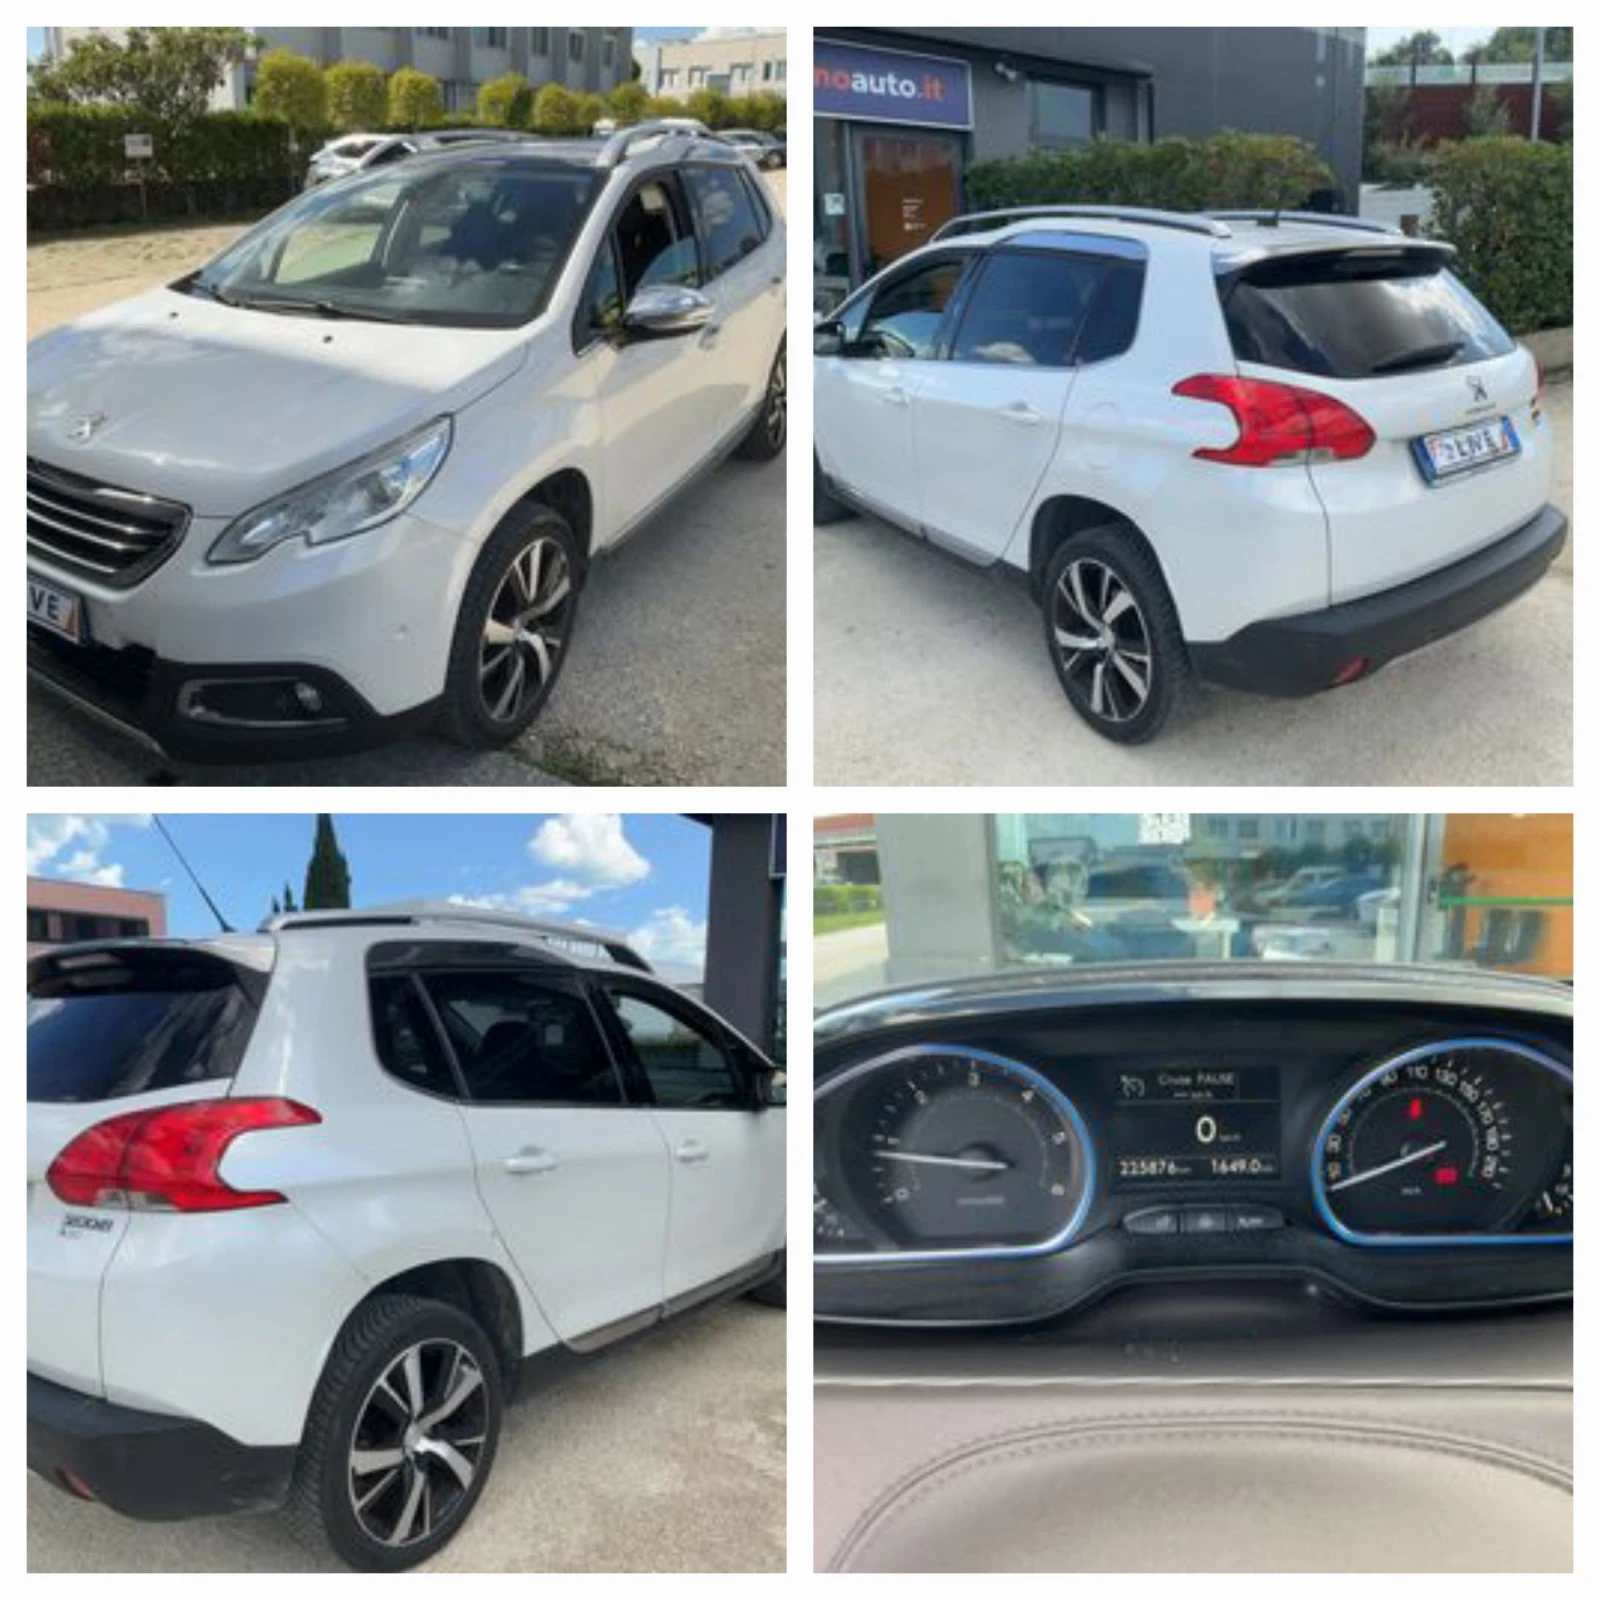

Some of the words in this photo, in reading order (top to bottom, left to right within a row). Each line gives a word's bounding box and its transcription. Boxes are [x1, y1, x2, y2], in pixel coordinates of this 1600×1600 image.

[1197, 1072, 1235, 1085] PAUSE
[1406, 1066, 1428, 1080] 110
[1196, 1116, 1217, 1144] 0
